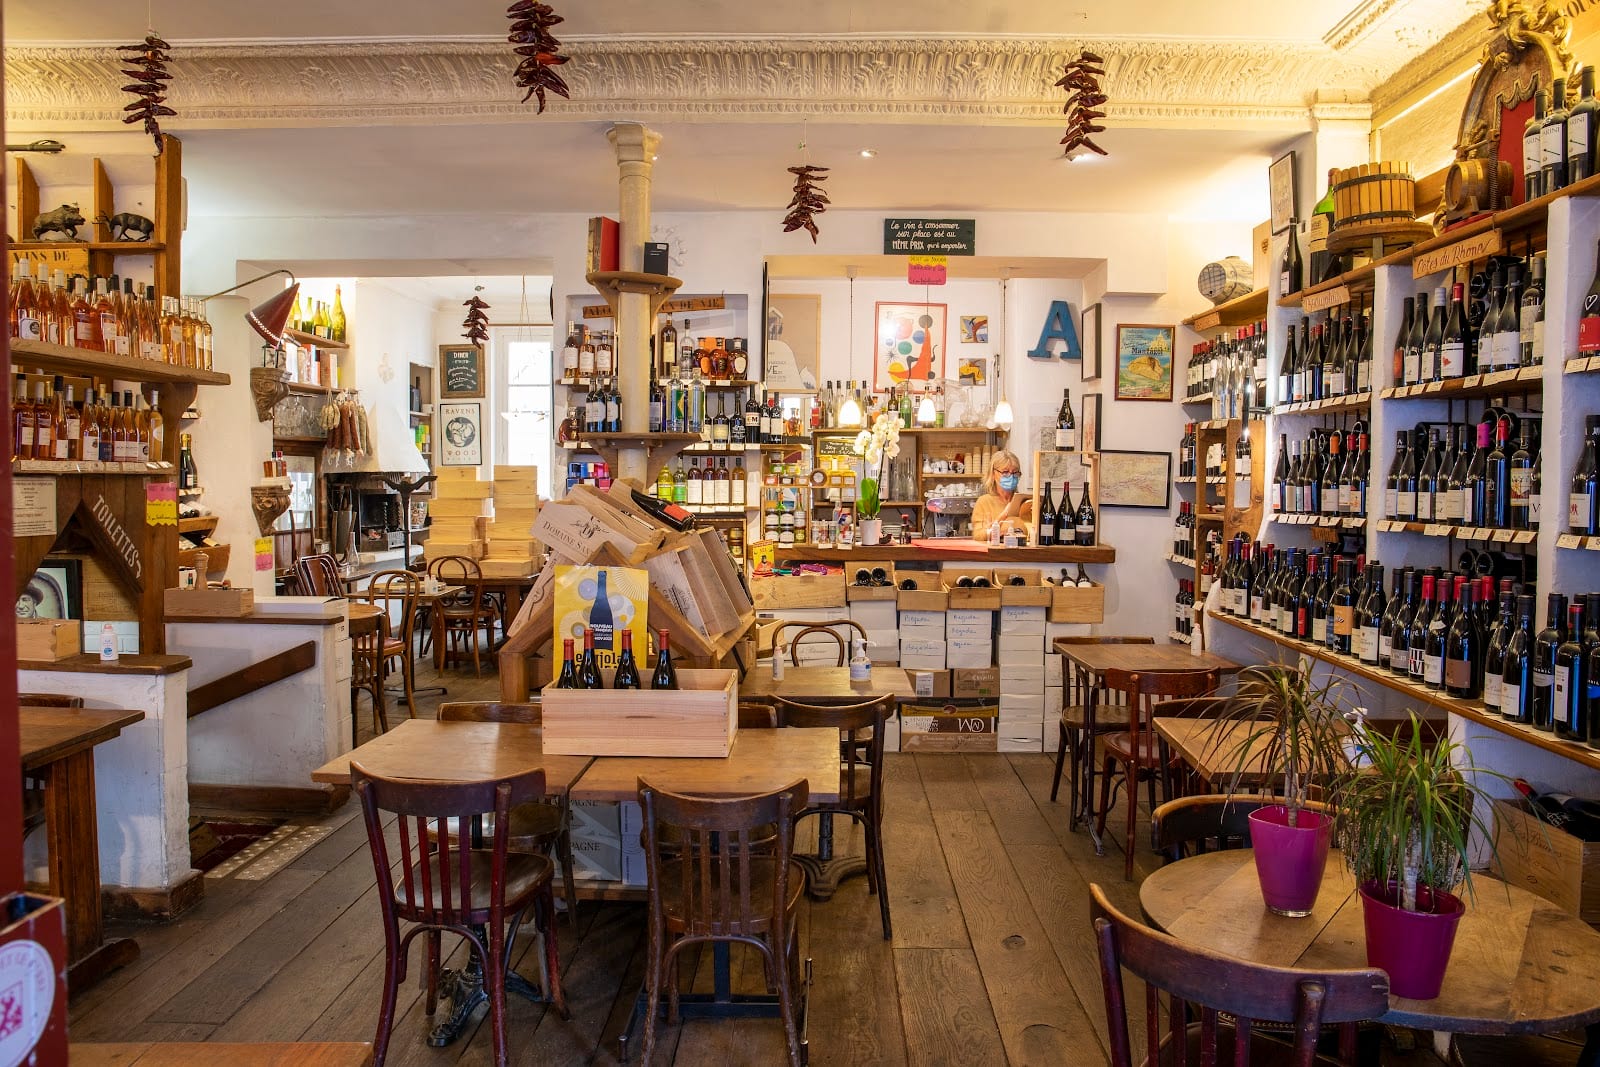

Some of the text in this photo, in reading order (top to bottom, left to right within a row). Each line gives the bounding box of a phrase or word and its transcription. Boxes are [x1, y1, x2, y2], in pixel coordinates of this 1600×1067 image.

[890, 220, 900, 230] Le
[903, 220, 916, 230] vin
[925, 222, 960, 230] consommer
[896, 230, 911, 238] sur
[911, 229, 932, 240] place
[934, 230, 945, 238] est
[892, 239, 908, 250] MÊME
[910, 240, 925, 250] PRIX
[941, 242, 968, 252] emporter
[13, 251, 70, 263] VINS DE
[1028, 301, 1081, 359] A
[92, 494, 140, 567] TOILETTES
